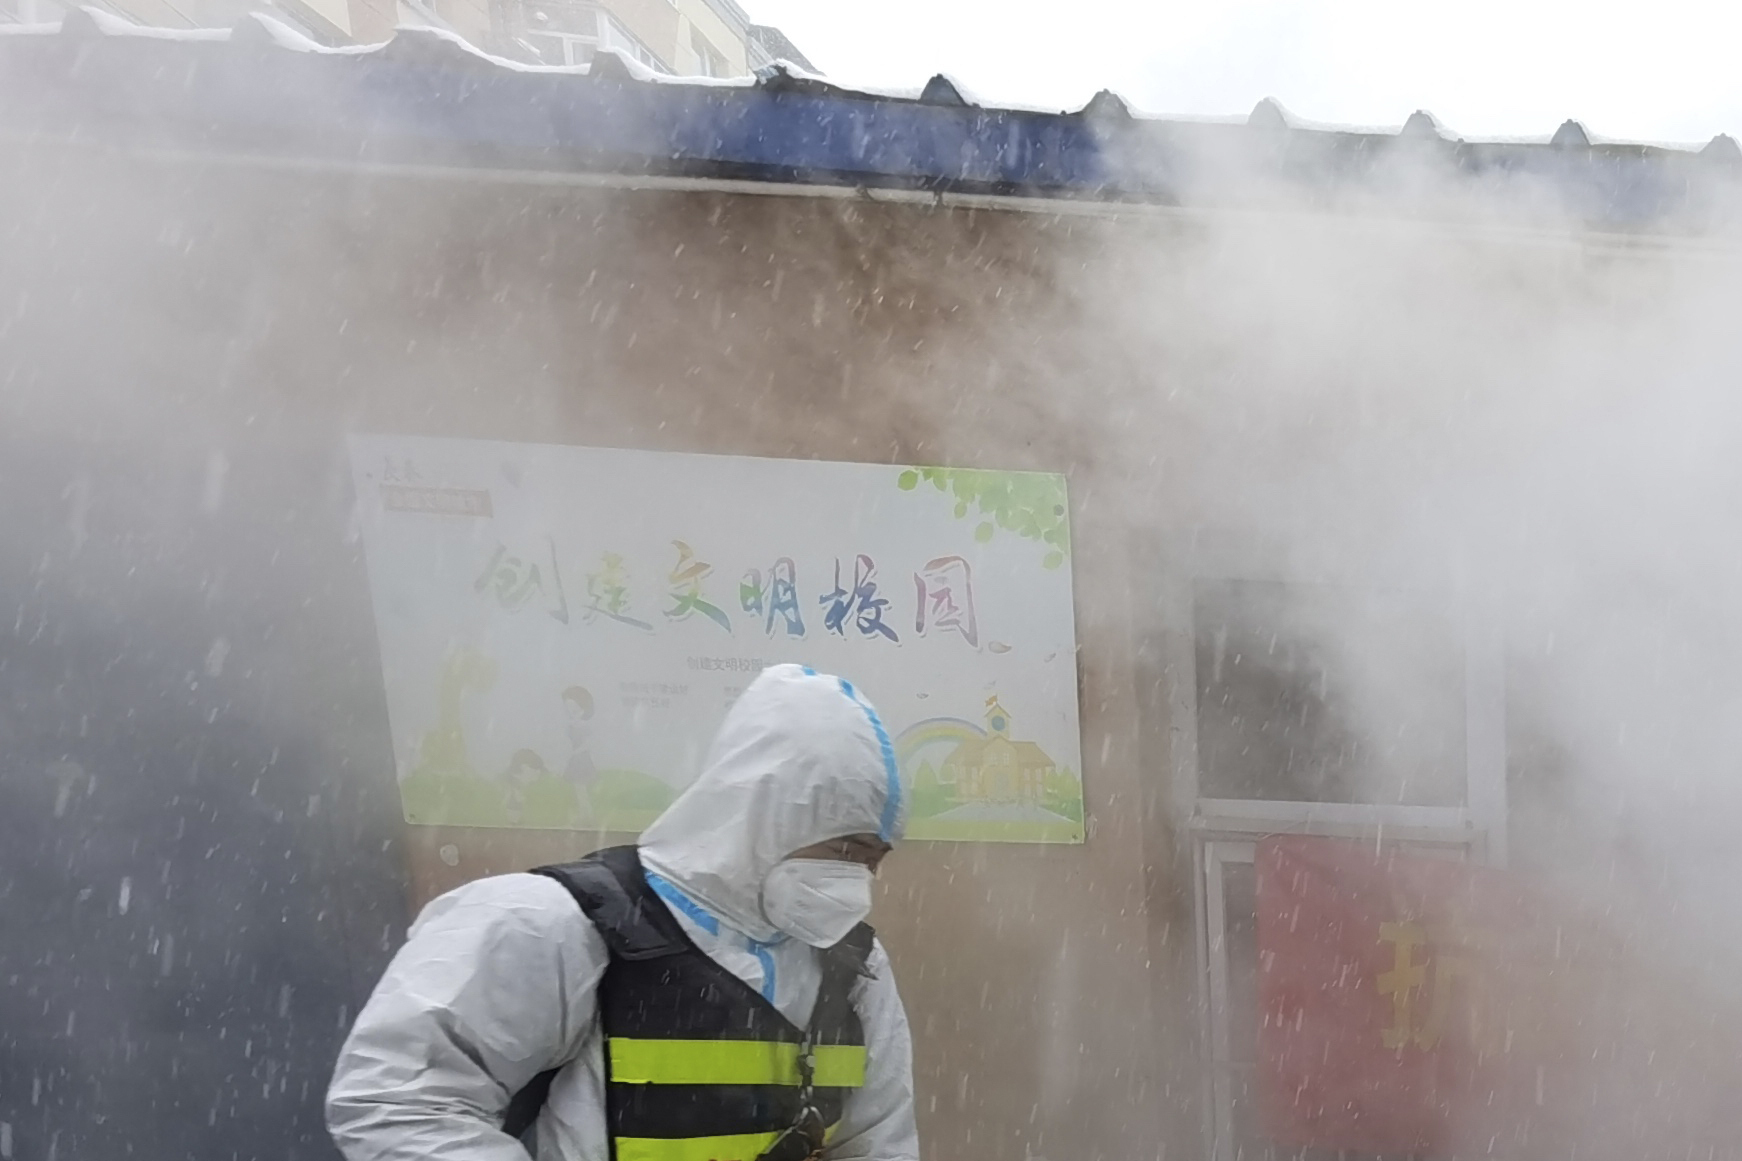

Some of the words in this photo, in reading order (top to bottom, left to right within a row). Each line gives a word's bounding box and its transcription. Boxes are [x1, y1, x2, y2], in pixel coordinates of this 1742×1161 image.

[474, 539, 981, 647] 创建文明校园
[687, 656, 780, 672] 创建文明校园
